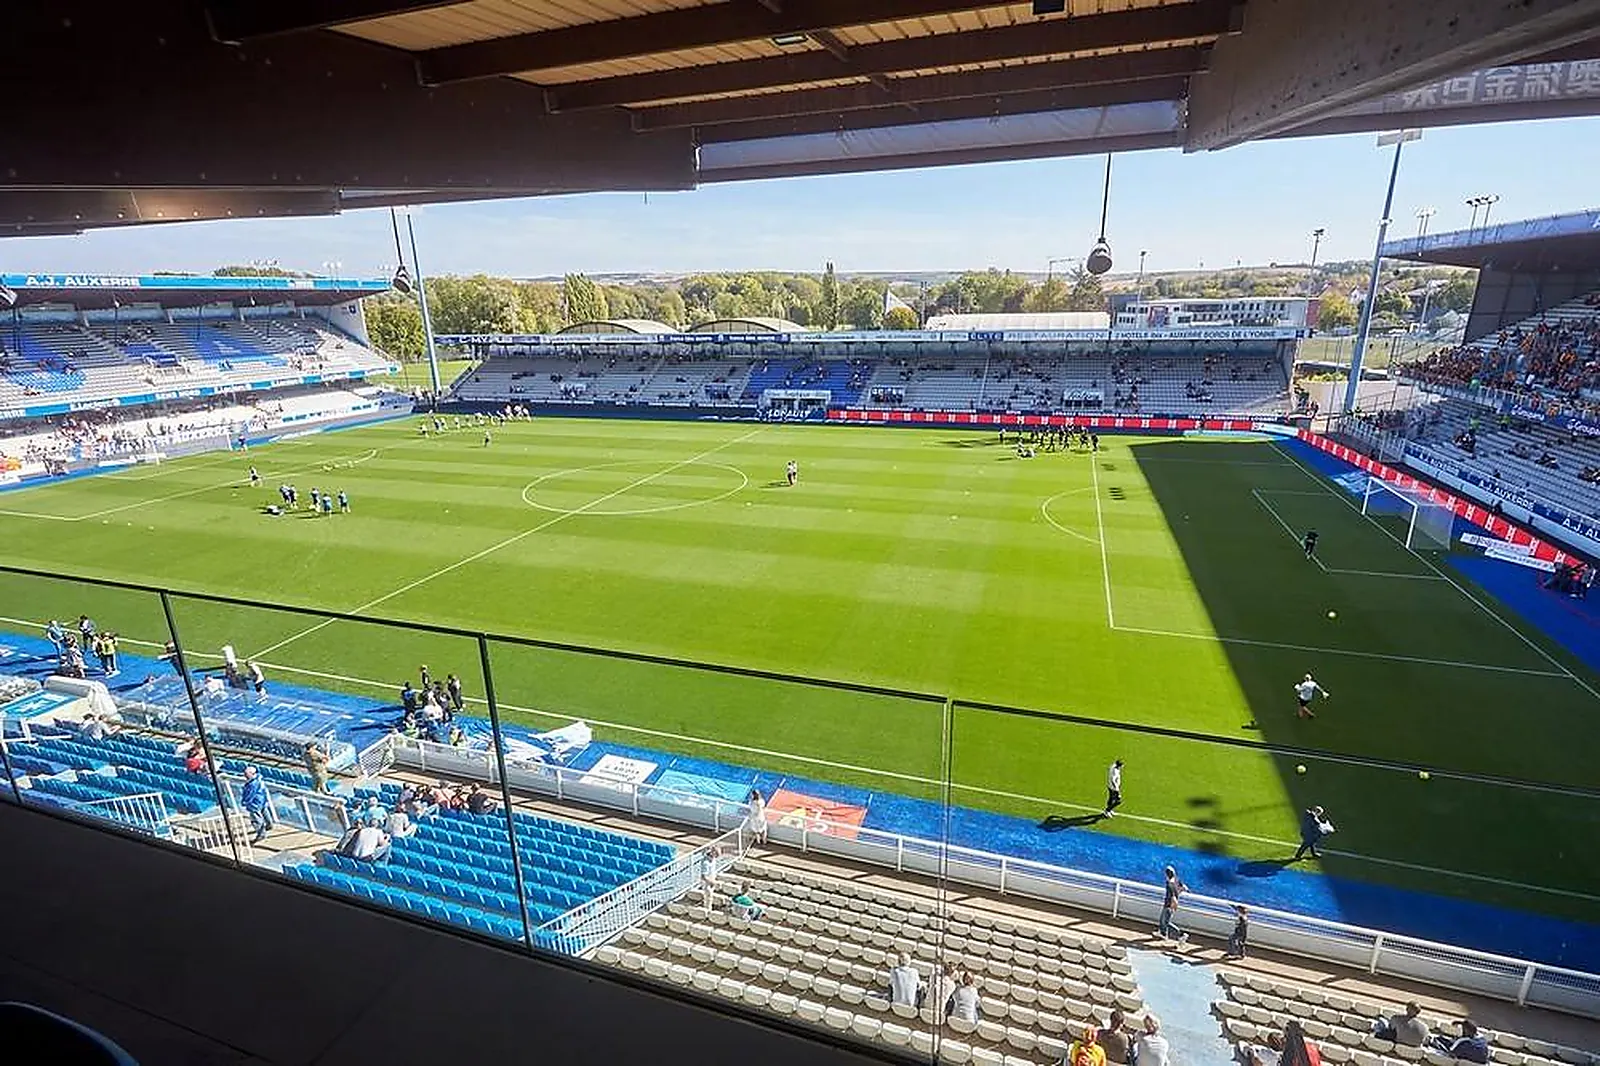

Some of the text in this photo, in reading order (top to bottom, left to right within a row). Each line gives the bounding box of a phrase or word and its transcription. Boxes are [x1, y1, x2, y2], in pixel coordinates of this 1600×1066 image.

[26, 276, 140, 286] A.J. AUXERRE
[1563, 518, 1583, 533] A.J.
